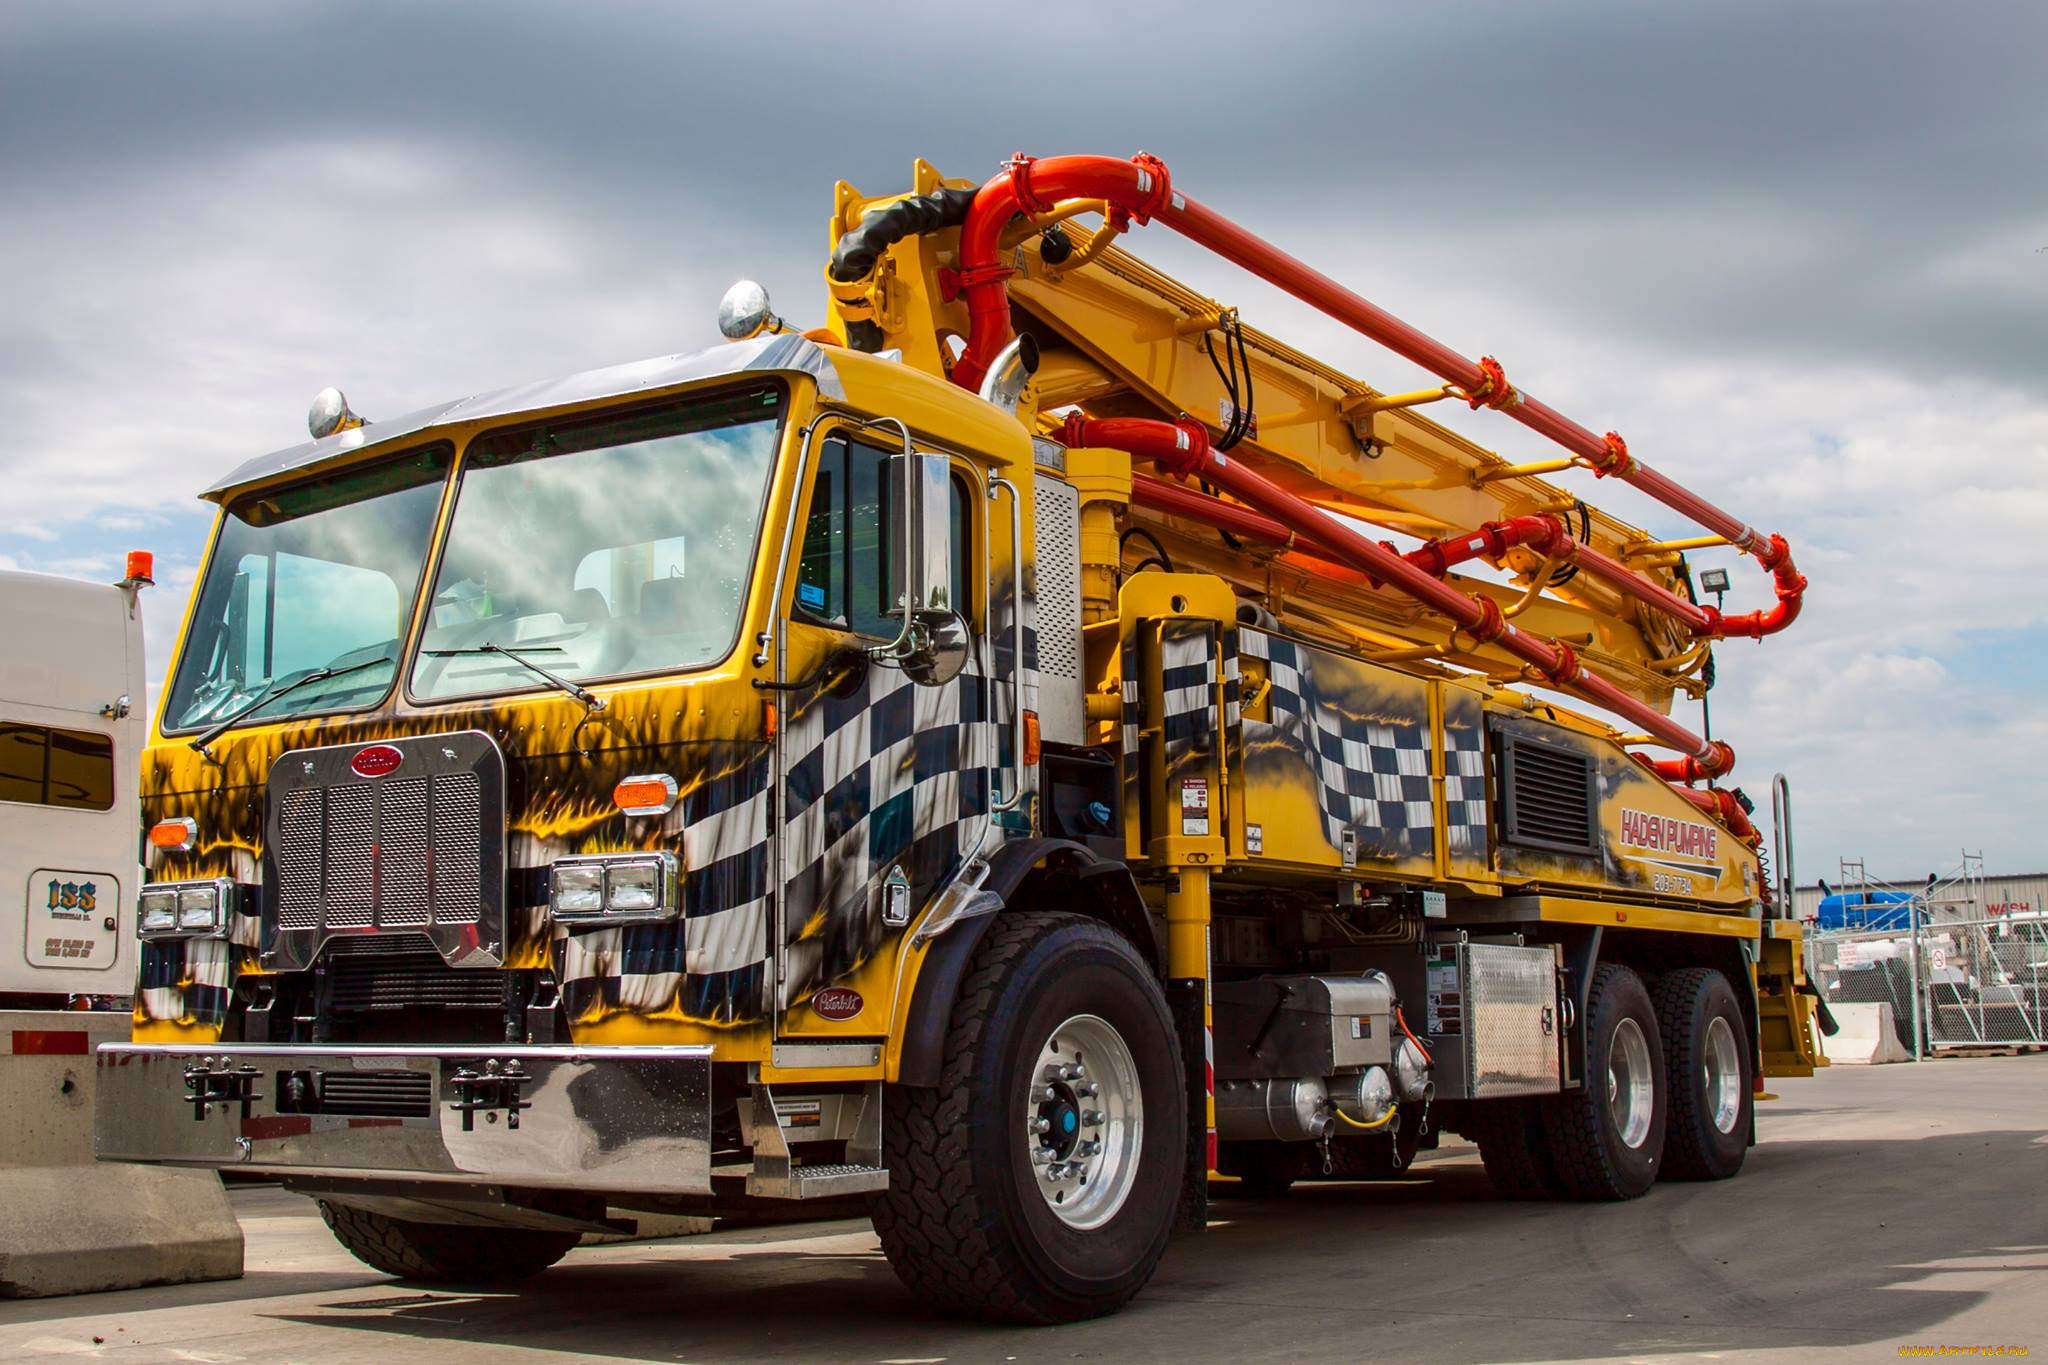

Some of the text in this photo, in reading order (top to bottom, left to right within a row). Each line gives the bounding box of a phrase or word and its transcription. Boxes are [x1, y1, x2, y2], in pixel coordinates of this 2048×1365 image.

[1620, 807, 1718, 861] HADEN PUMPING
[47, 878, 96, 913] ISS
[819, 992, 860, 1012] Peterbilt
